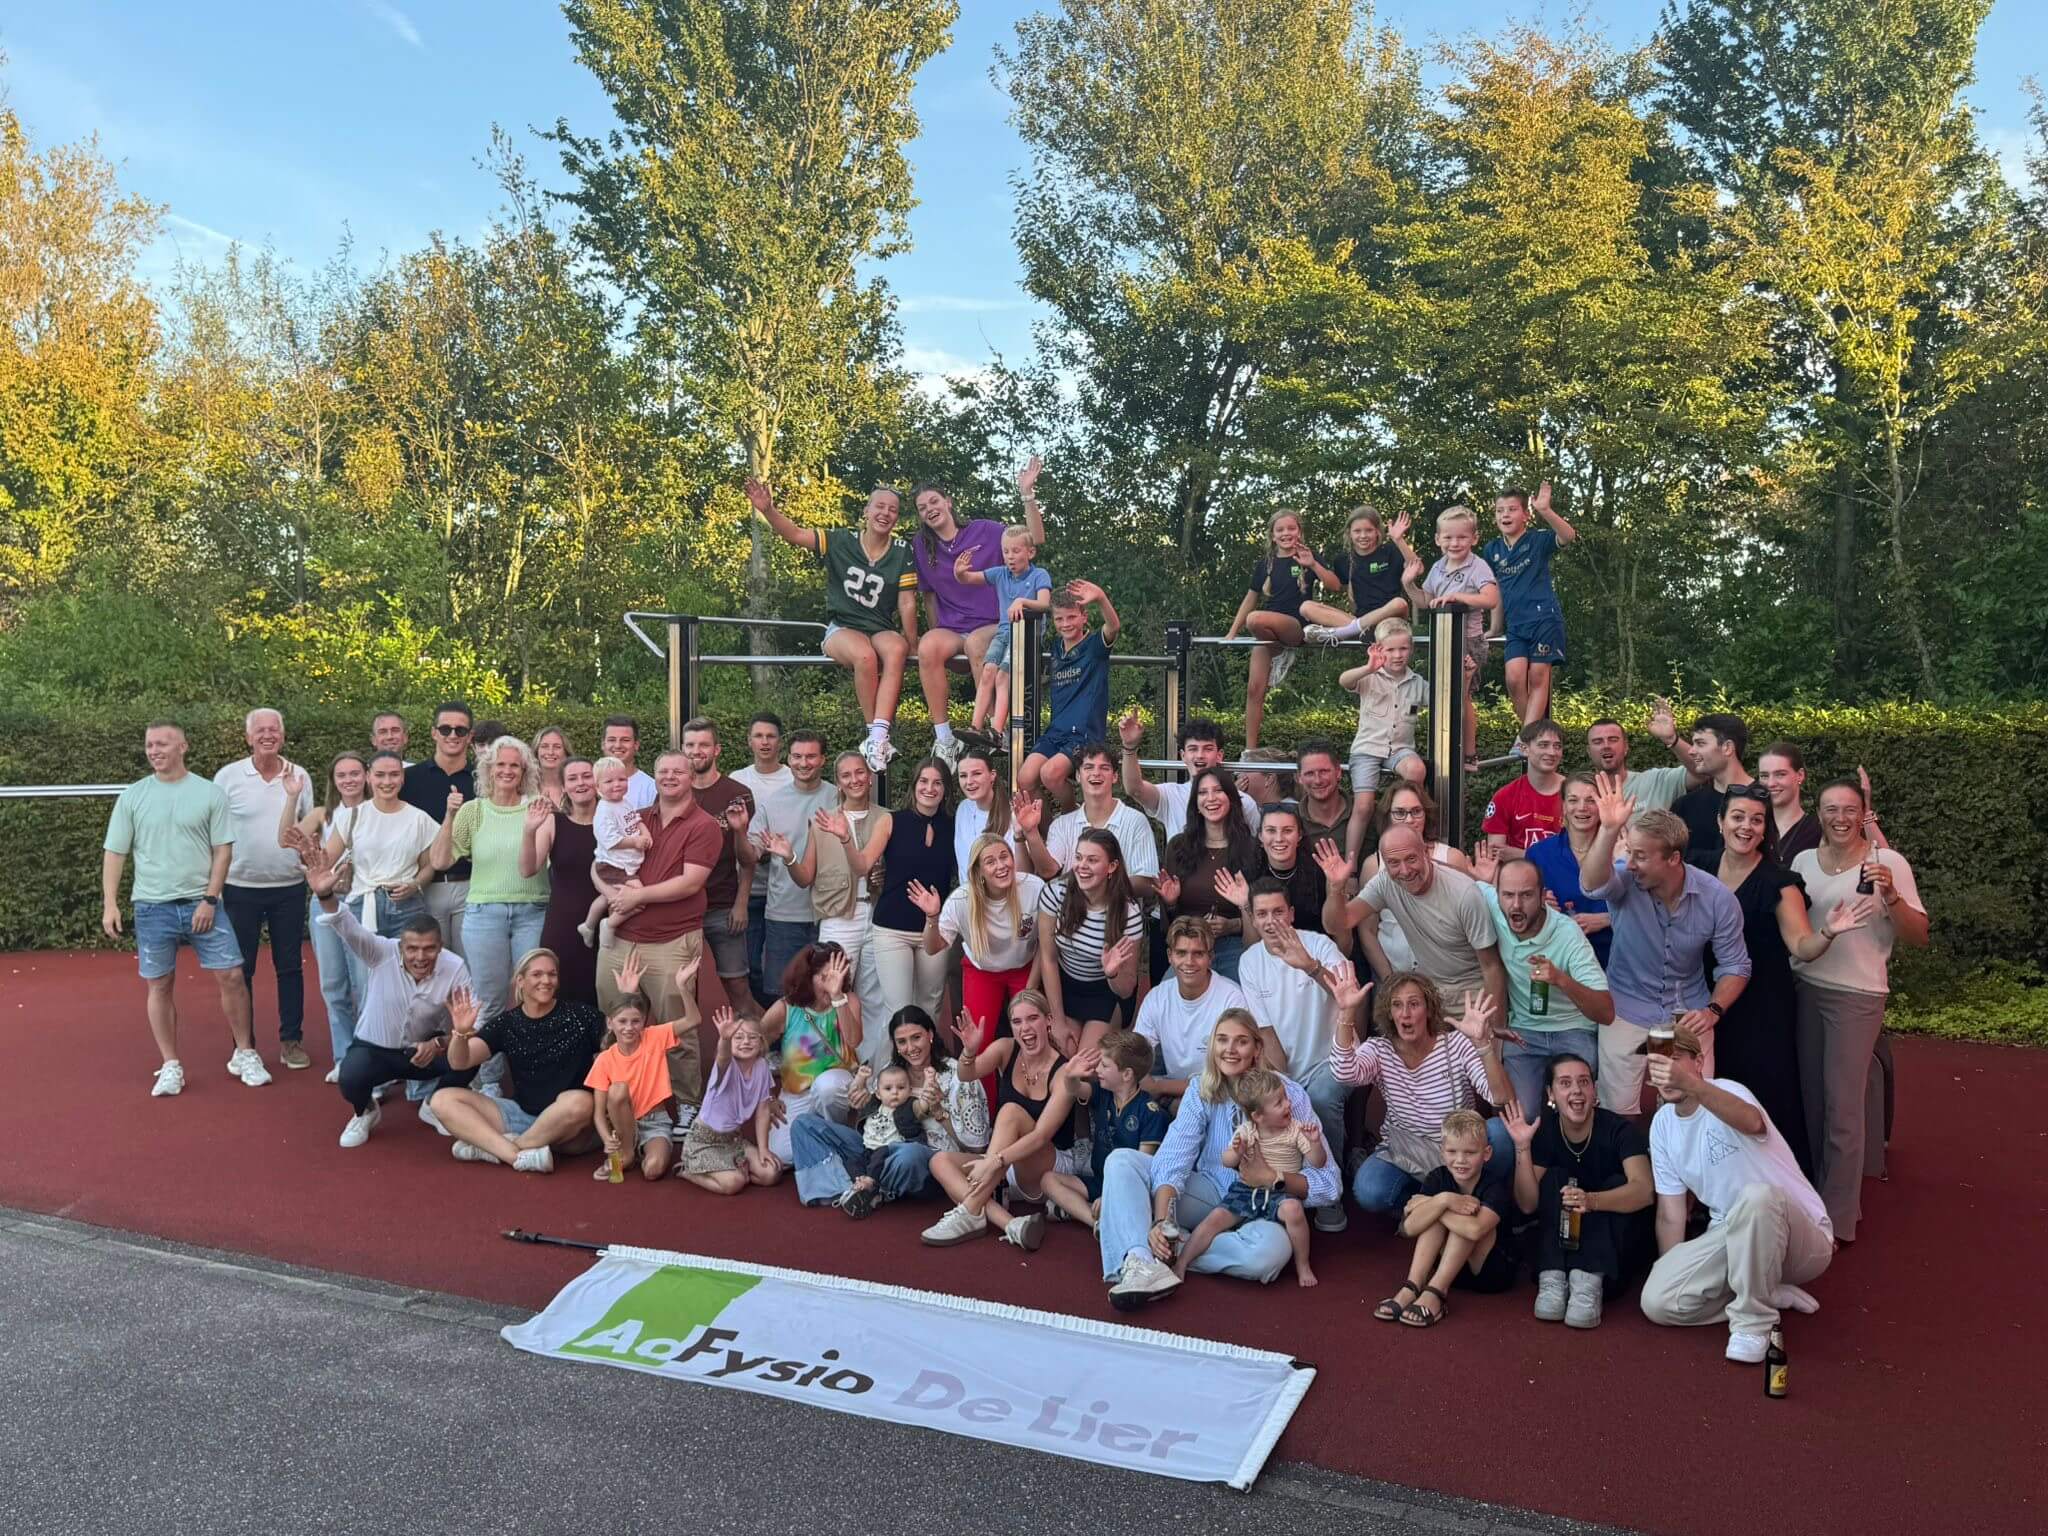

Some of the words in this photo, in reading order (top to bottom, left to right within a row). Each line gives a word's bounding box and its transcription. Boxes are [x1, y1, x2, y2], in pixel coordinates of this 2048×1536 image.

[843, 566, 885, 609] 23
[572, 1319, 874, 1394] AdFysio
[892, 1368, 1013, 1423] De
[1027, 1396, 1198, 1459] Lier
